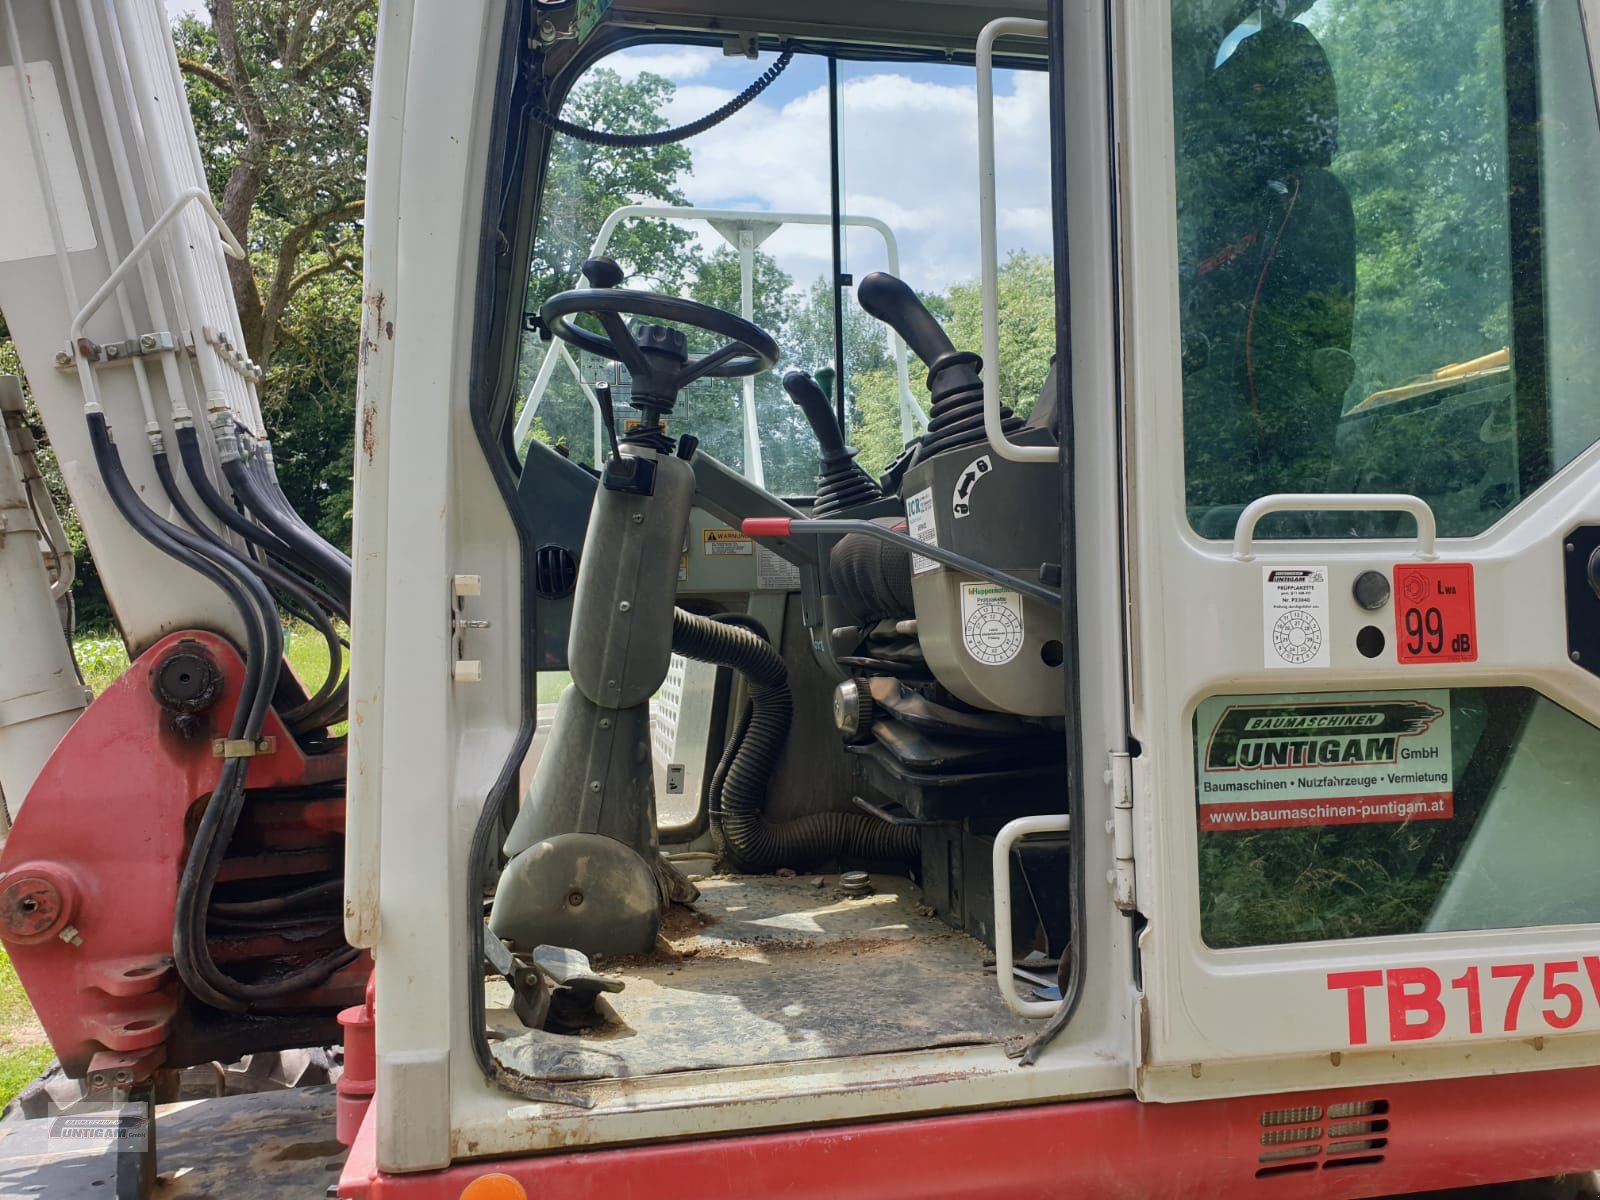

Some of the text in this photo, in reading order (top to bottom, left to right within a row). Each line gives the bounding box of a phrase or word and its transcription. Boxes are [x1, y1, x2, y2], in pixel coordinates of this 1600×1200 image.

[1405, 607, 1443, 655] 99
[1452, 633, 1471, 653] dB
[1251, 714, 1378, 729] BAUMASCHINEN
[1401, 747, 1439, 760] GmbH
[1204, 771, 1448, 792] Baumaschinen Nutzfahrzeuge Vermietung
[1210, 799, 1444, 823] www.baumaschinen-puntigam.at
